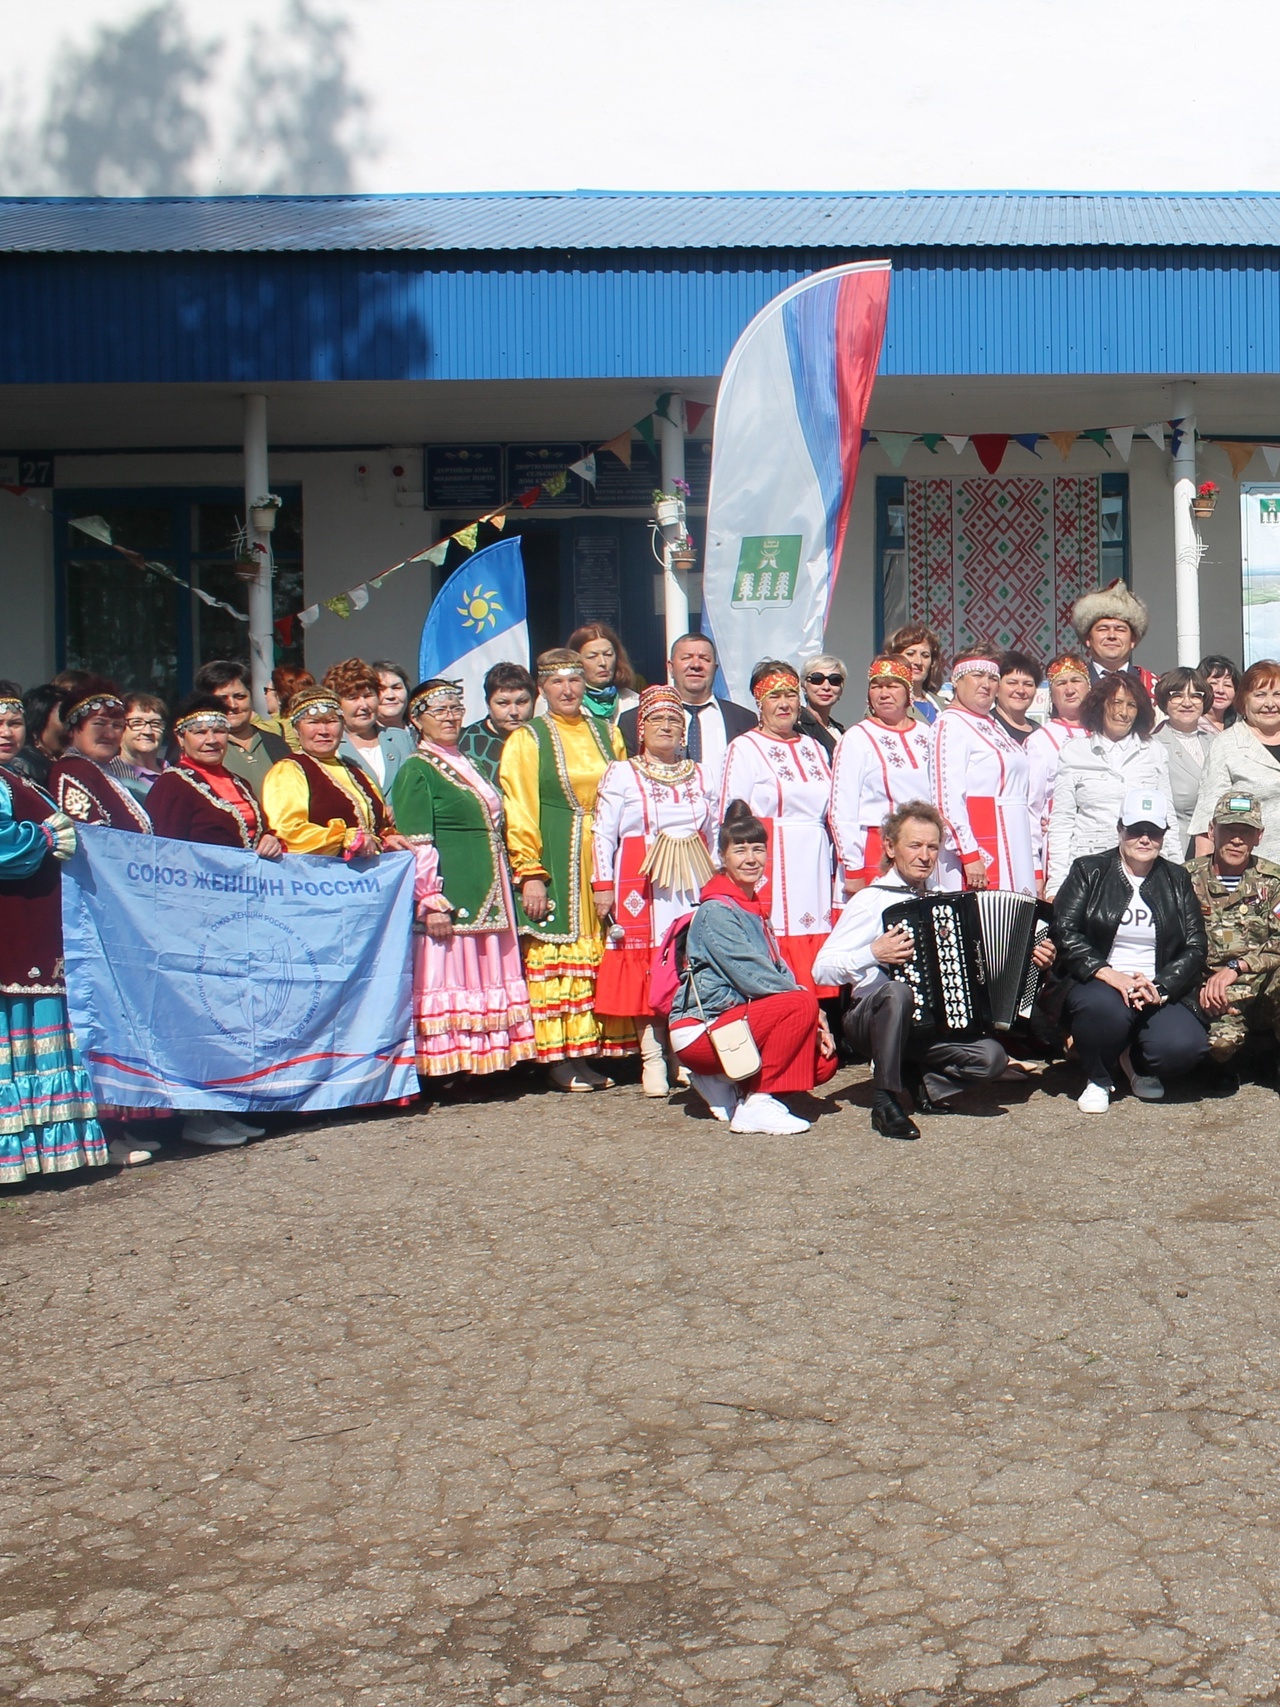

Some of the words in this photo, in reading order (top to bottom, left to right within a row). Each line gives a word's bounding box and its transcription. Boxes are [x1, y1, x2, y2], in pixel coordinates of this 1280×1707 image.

[22, 461, 51, 483] 27
[126, 861, 188, 887] СОЮЗ
[193, 871, 285, 898] ЖЕНЩИН
[290, 876, 381, 897] РОССИИ
